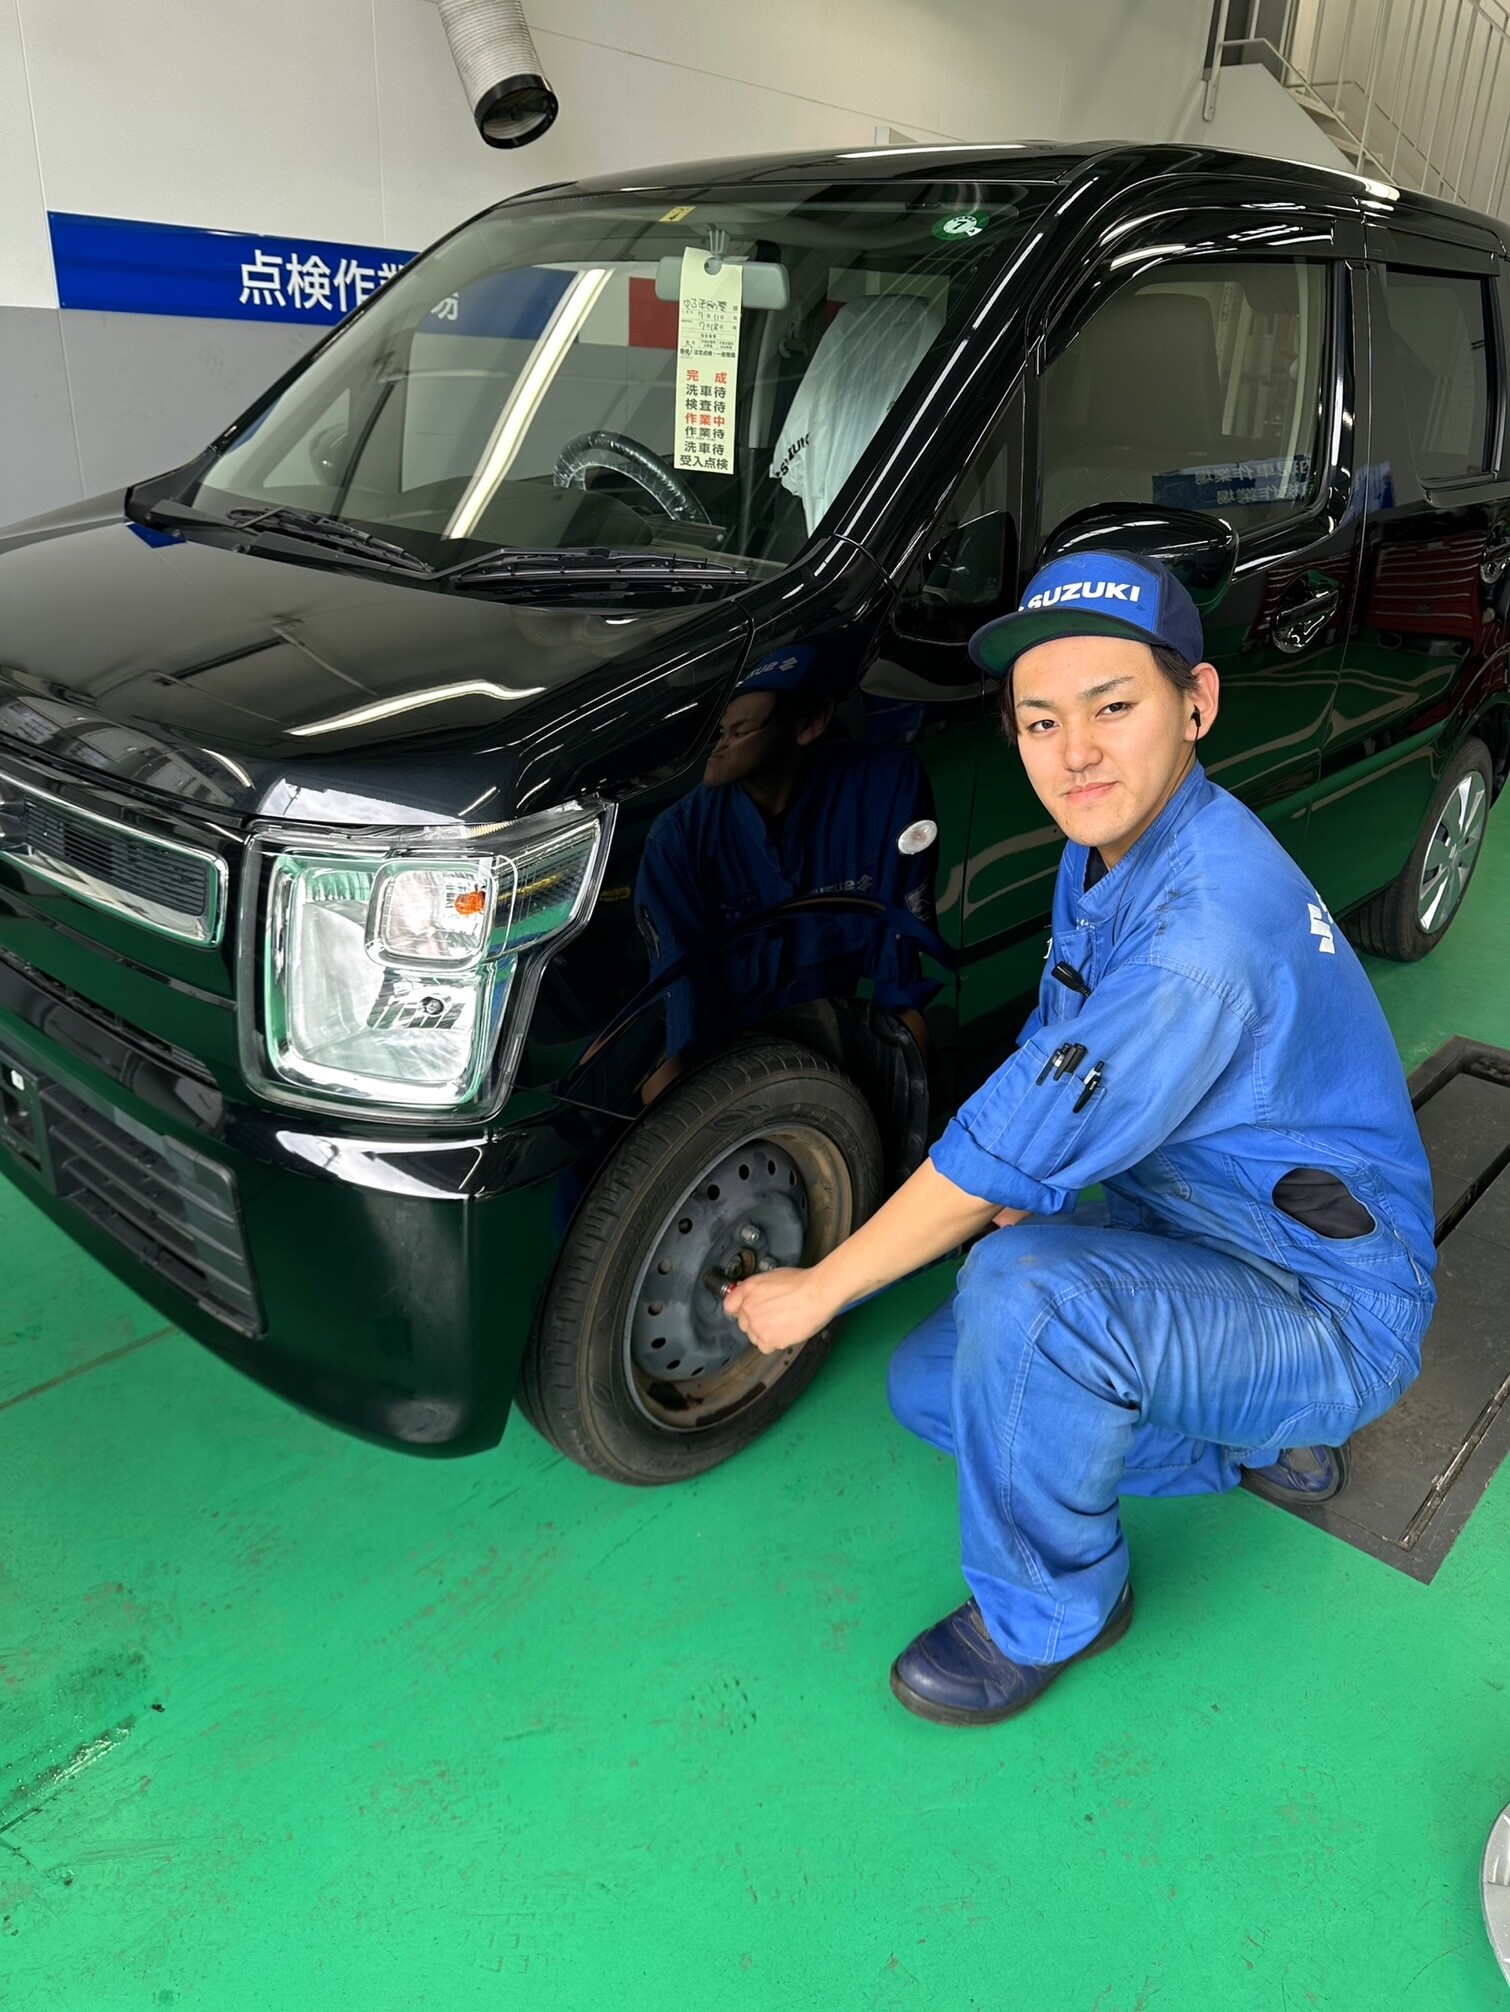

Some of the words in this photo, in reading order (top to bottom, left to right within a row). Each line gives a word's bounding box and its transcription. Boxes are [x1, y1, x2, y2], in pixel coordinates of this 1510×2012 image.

[952, 221, 968, 230] 7
[685, 383, 727, 399] 洗車待
[685, 398, 726, 413] 検査待
[685, 412, 725, 427] 作業中
[684, 426, 725, 439] 作業待
[684, 440, 725, 456] 洗車待
[680, 454, 728, 470] 受入点検
[1027, 581, 1140, 609] SUZUKI
